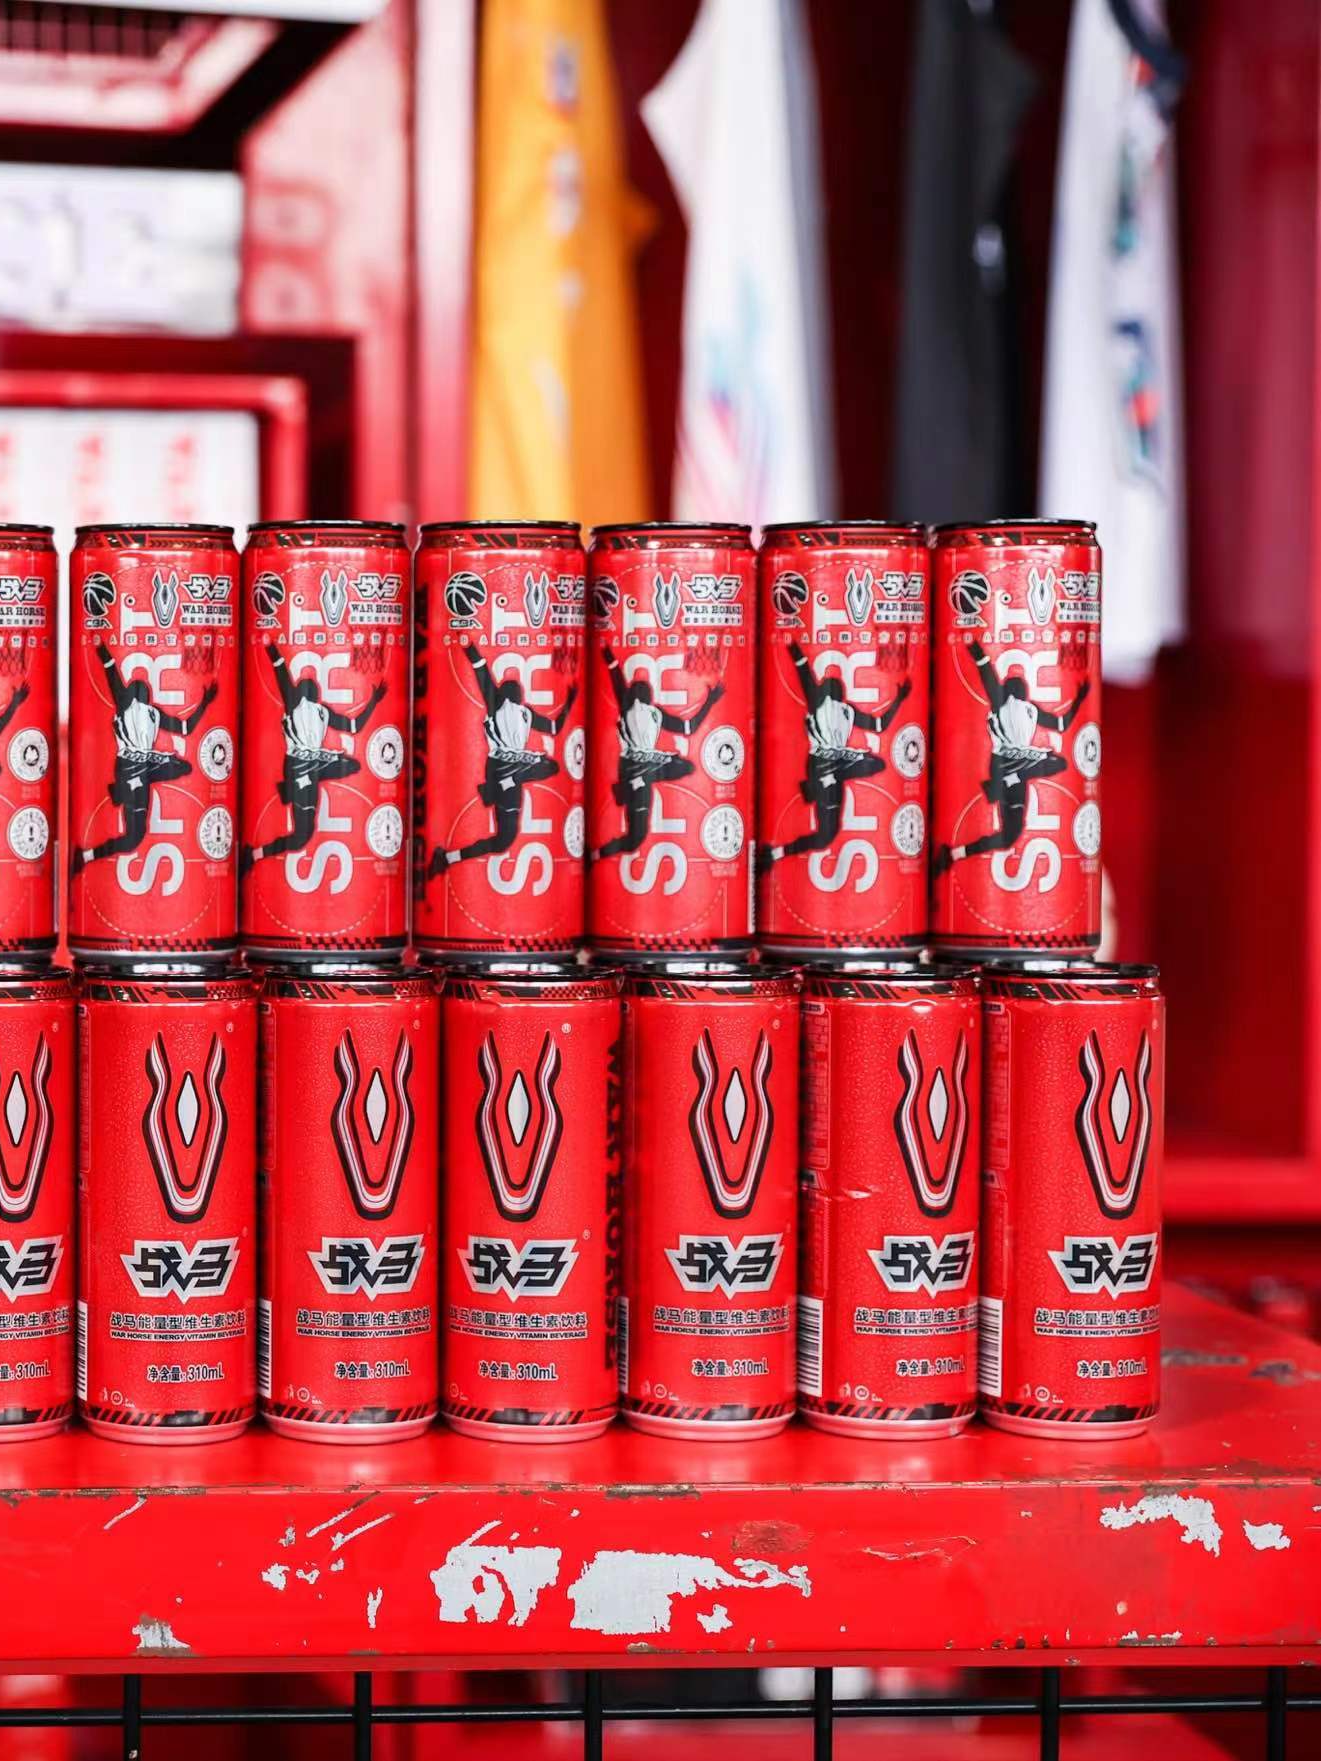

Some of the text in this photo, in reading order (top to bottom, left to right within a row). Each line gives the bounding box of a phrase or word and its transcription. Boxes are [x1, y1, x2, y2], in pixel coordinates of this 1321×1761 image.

[683, 574, 743, 601] 战马
[15, 606, 46, 617] HORSE
[181, 604, 205, 615] WAR
[350, 603, 374, 614] WAR
[684, 604, 742, 615] WAR HORSE
[85, 619, 112, 628] CBA
[130, 1243, 234, 1293] 战马
[317, 1240, 420, 1290] 战马
[464, 1242, 570, 1290] 战马
[675, 1239, 778, 1289] 战马
[879, 1237, 972, 1287] 战马
[1060, 1239, 1154, 1288] 战马
[111, 1309, 246, 1330] 战马能量型维生素饮料
[855, 1303, 978, 1324] 战马能量型维生素
[15, 1330, 43, 1338] VITAMIN
[110, 1331, 126, 1339] WAR
[127, 1332, 153, 1340] HORSE
[186, 1332, 217, 1340] VITAMIN
[297, 1328, 313, 1336] WAR
[314, 1329, 340, 1337] HORSE
[375, 1328, 403, 1337] VITAMIN
[516, 1331, 549, 1339] VITAMIN
[549, 1330, 587, 1339] BEVERAGE
[671, 1326, 698, 1335] HORSE
[733, 1327, 762, 1336] VITAMIN
[855, 1325, 874, 1334] WAR
[16, 1361, 50, 1378] 310mL
[188, 1362, 223, 1381] 310mL
[376, 1360, 410, 1377] 310mL
[518, 1363, 558, 1380] 310mL
[734, 1357, 769, 1376] 310mL
